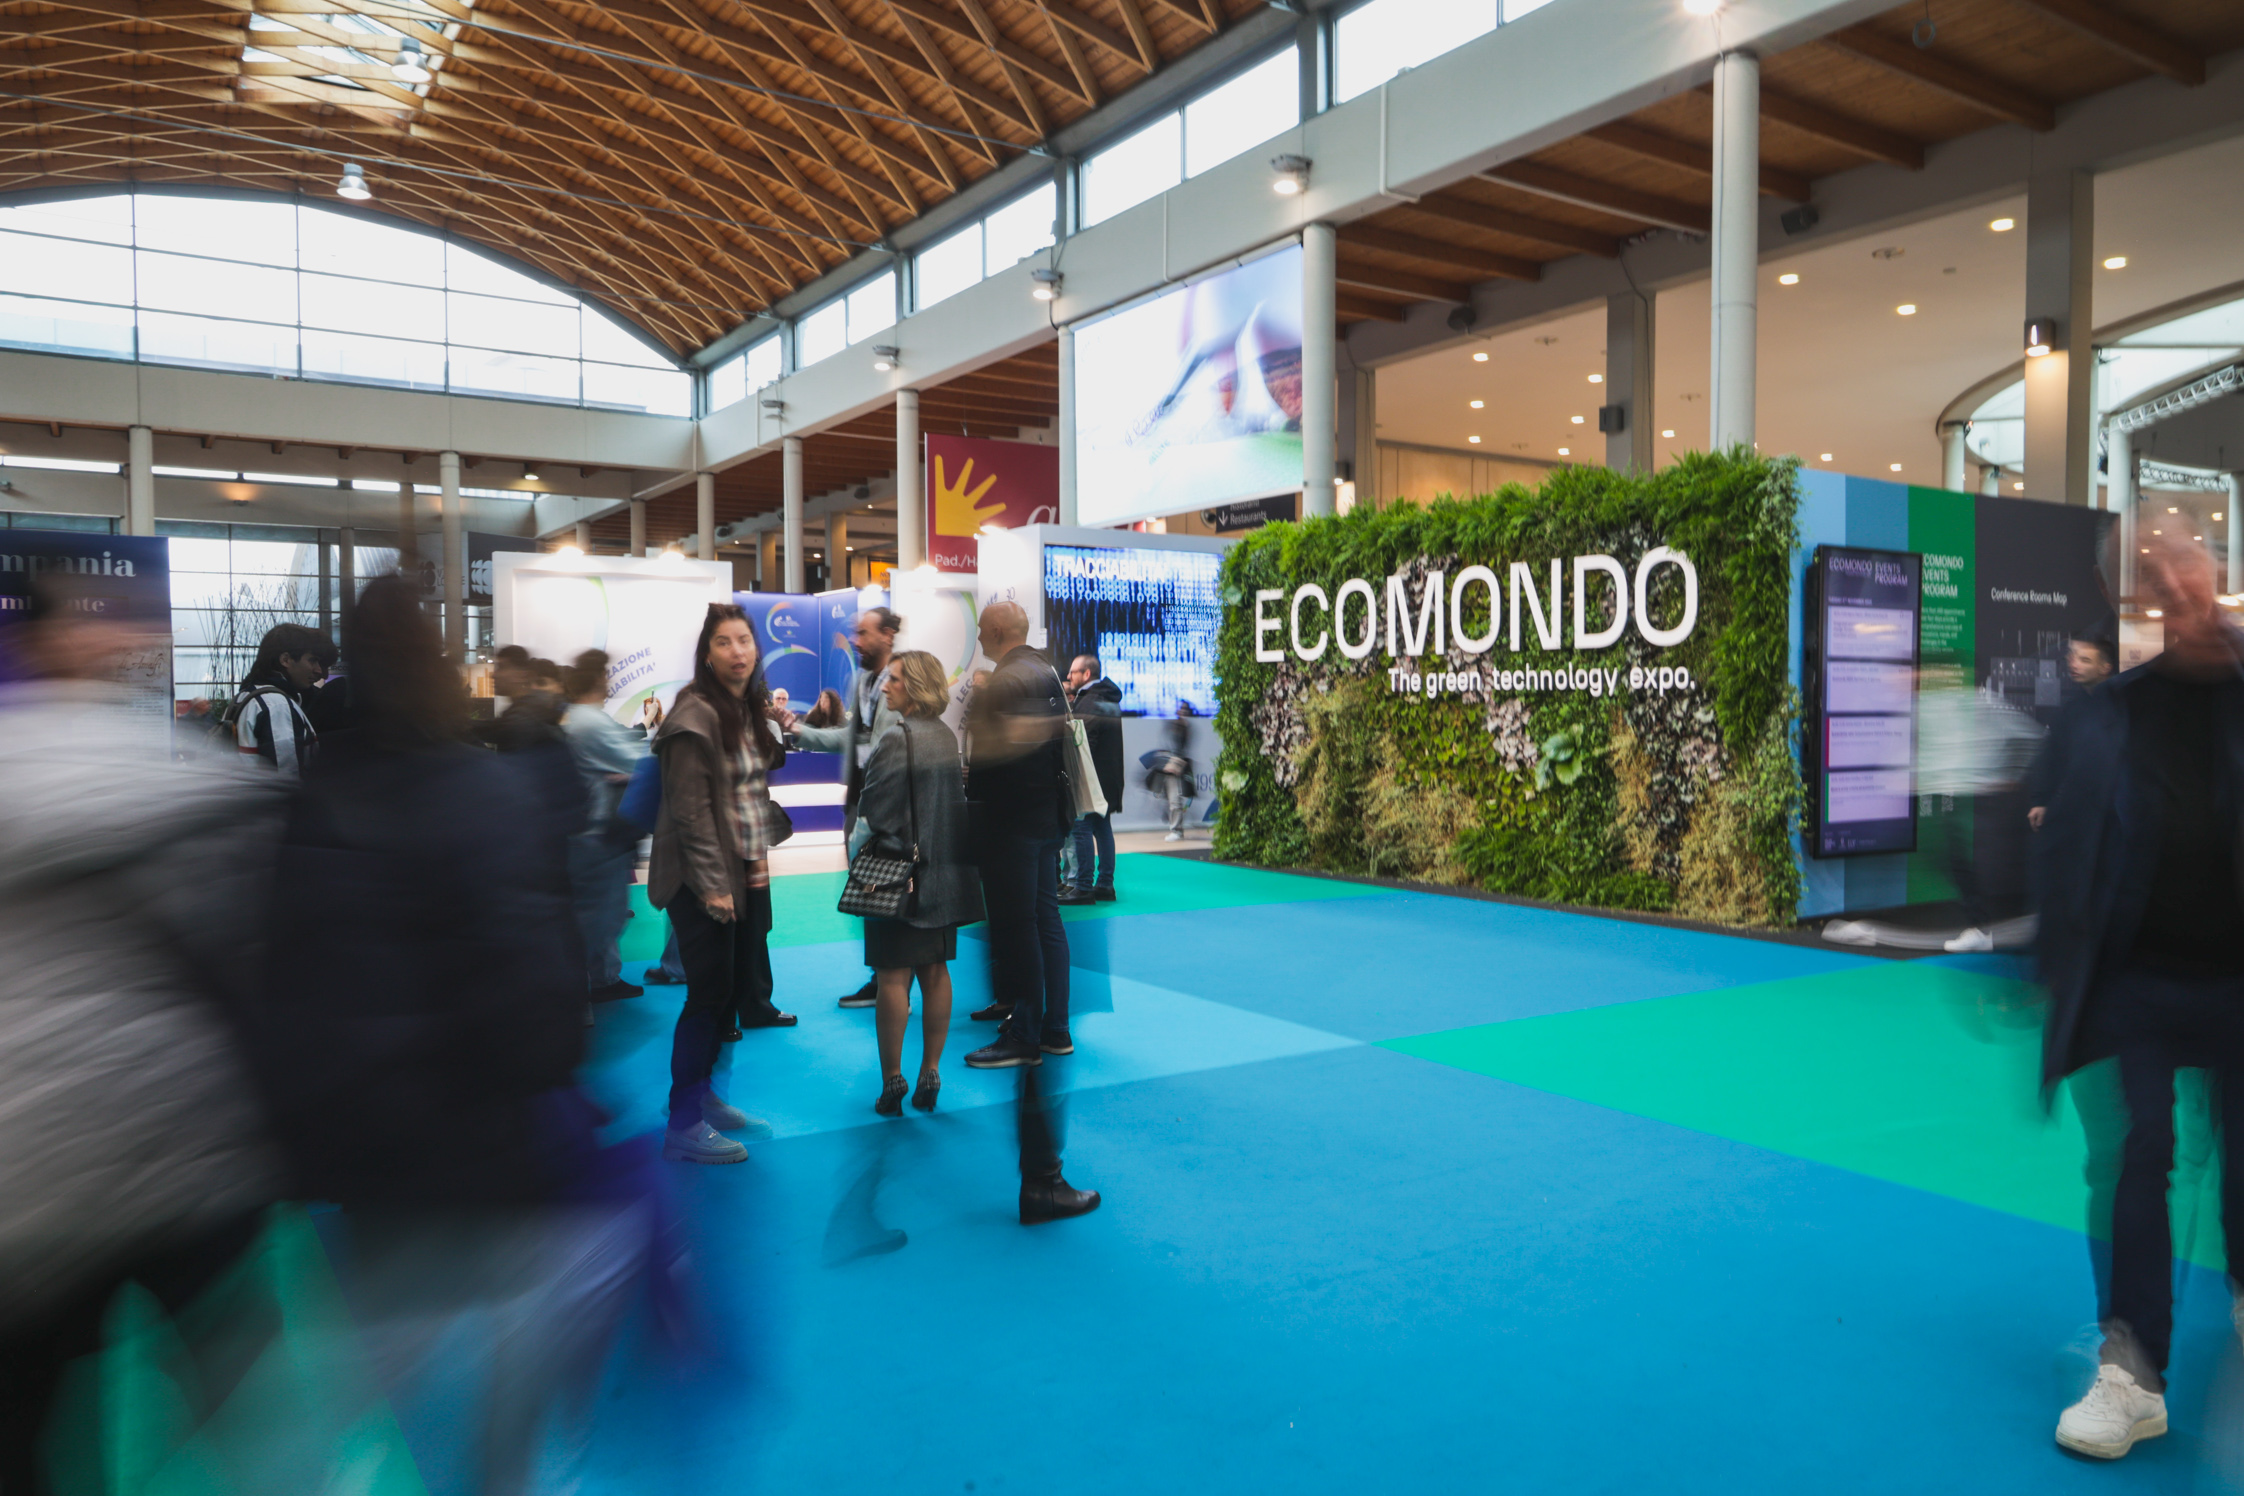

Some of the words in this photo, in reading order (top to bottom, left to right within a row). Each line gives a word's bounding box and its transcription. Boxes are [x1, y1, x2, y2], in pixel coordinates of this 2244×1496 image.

[1230, 510, 1267, 525] Restaurants
[1922, 553, 1964, 571] COMONDO
[1922, 568, 1950, 583] VENTS
[1256, 545, 1698, 662] ECOMONDO
[1991, 587, 2028, 603] Conference
[2029, 589, 2052, 605] Rooms
[2053, 590, 2068, 608] Map
[604, 662, 656, 704] CIABILITA'
[1388, 666, 1421, 692] The
[1426, 669, 1481, 699] green
[1492, 662, 1618, 697] technology
[1629, 665, 1695, 697] expo.
